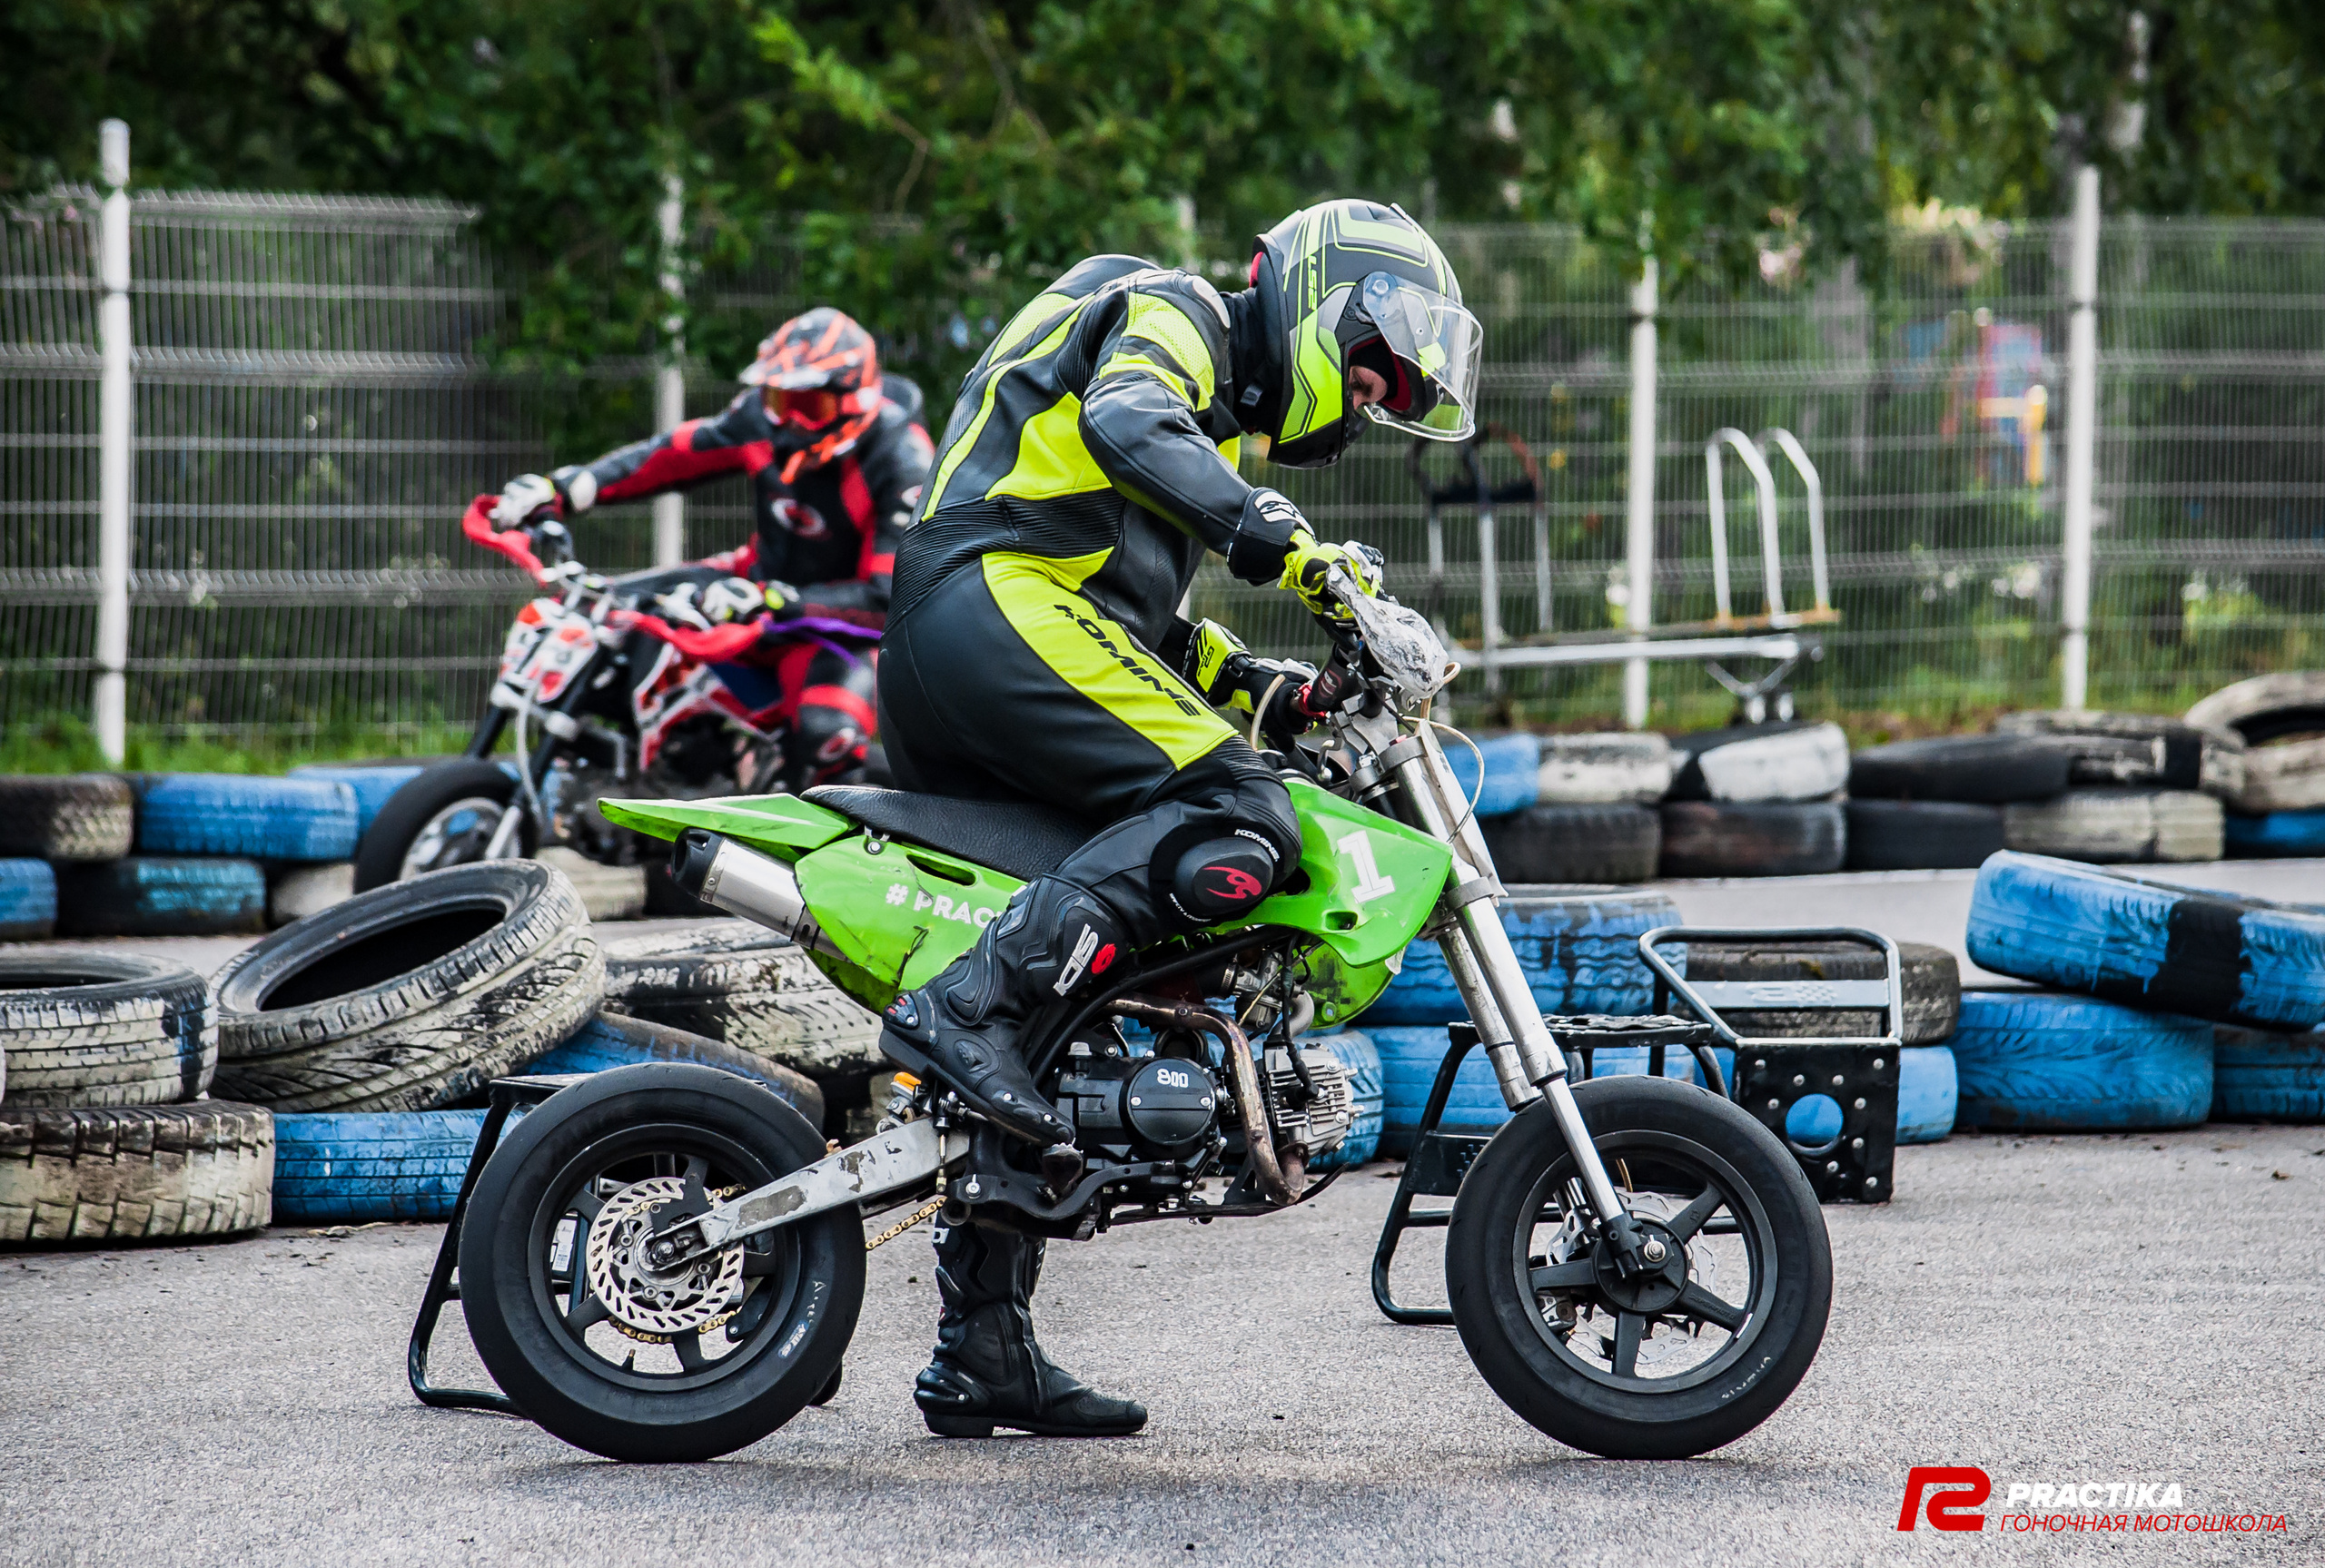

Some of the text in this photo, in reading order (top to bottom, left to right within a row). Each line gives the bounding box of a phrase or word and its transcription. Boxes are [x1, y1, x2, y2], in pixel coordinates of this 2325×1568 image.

[1308, 255, 1317, 311] LS2
[1054, 605, 1201, 715] KOMINE
[1337, 829, 1396, 904] 1
[914, 890, 1003, 928] PRAC
[1156, 1068, 1189, 1089] 800
